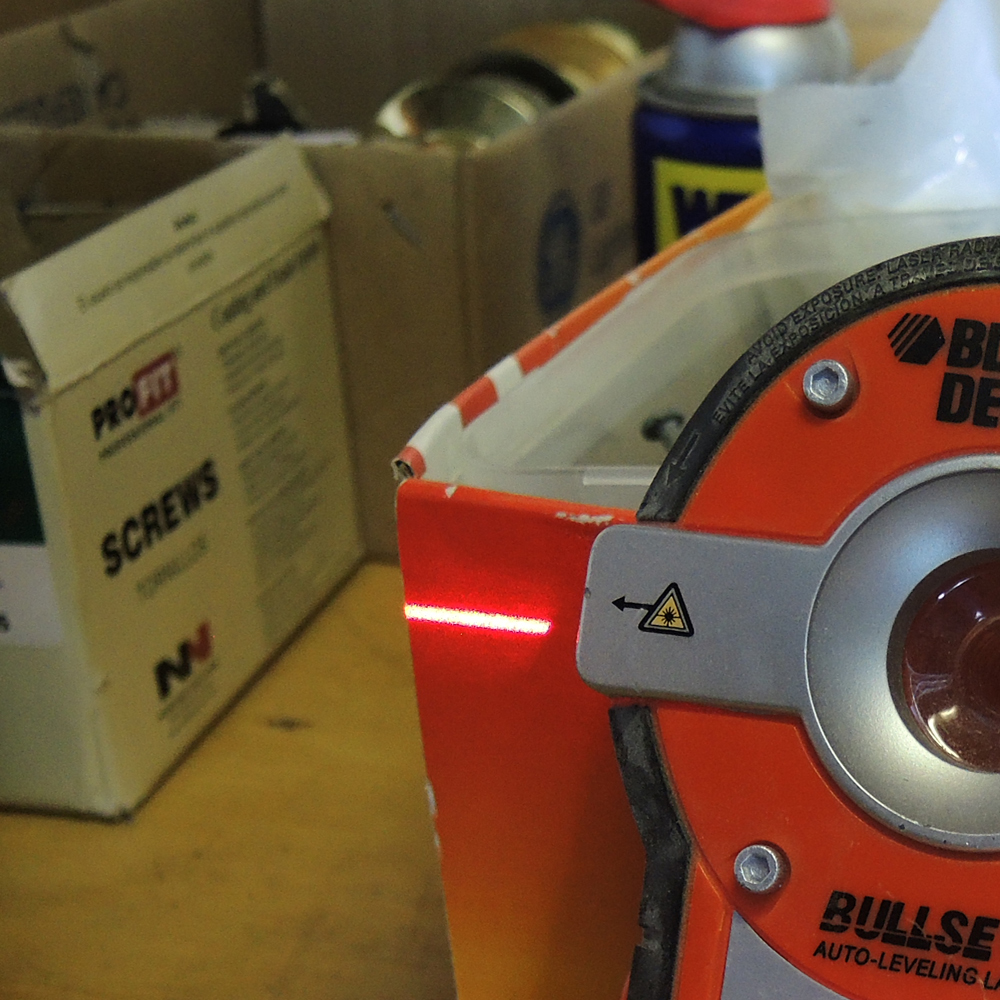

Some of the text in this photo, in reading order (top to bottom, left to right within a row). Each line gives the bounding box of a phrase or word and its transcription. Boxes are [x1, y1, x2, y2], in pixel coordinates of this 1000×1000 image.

[742, 320, 790, 365] AVOID
[710, 379, 751, 424] EVITE
[101, 457, 220, 578] SCREWS
[813, 940, 978, 986] AUTO-LEVELING
